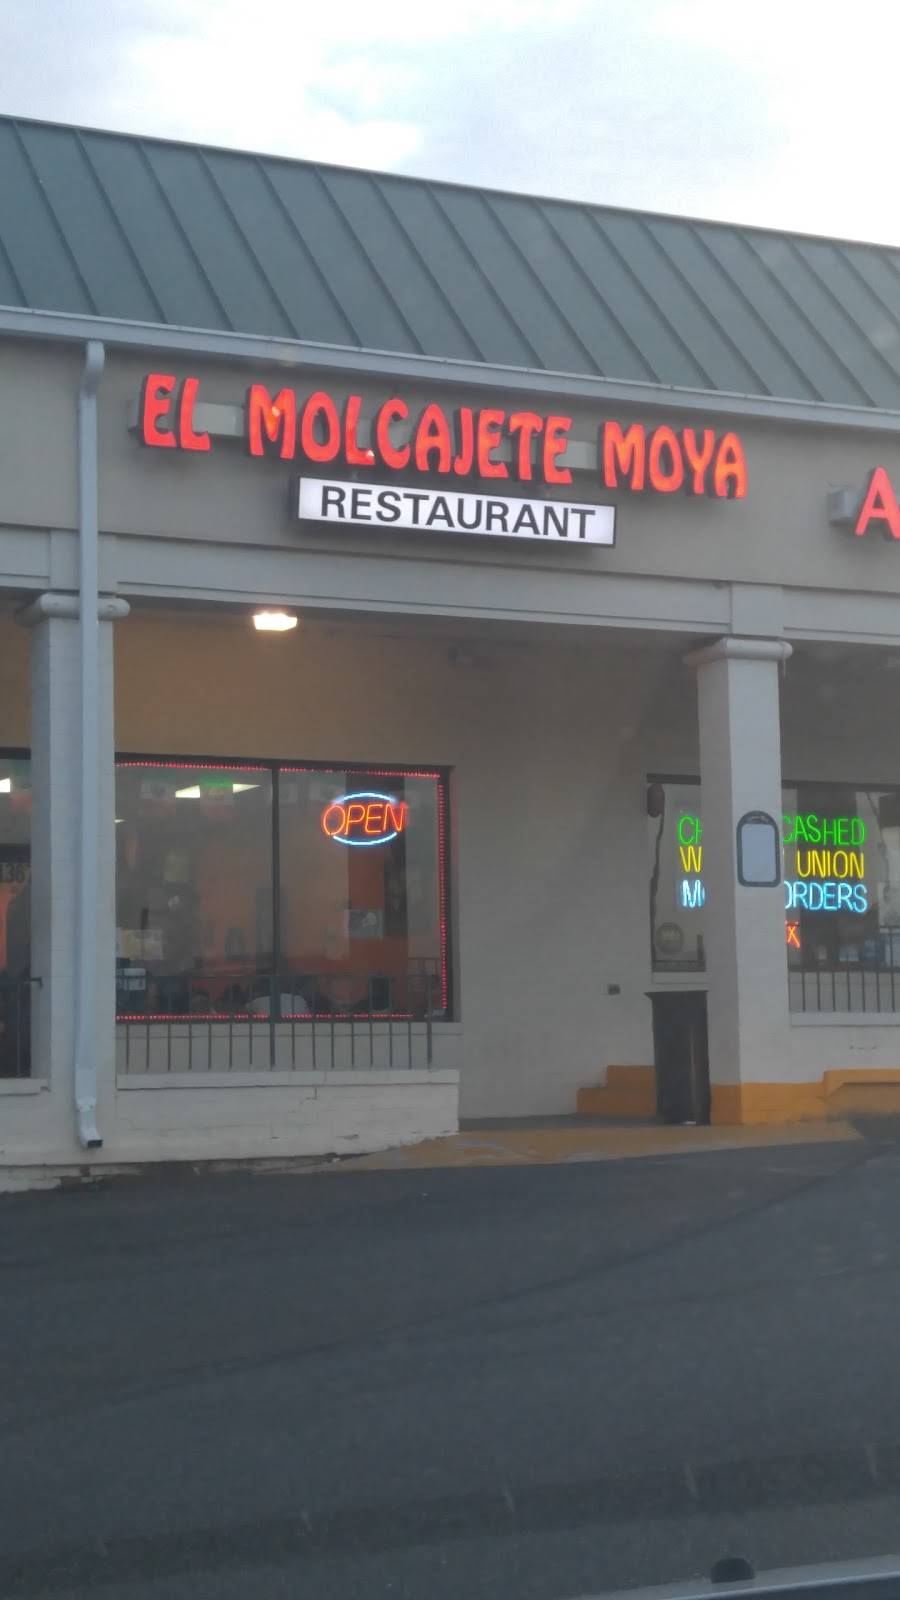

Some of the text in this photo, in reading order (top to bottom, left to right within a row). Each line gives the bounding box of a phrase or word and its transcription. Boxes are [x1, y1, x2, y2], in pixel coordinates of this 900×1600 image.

[143, 374, 748, 499] EL MOLCAJETE MOYA
[321, 485, 596, 539] RESTAURANT
[321, 803, 408, 836] OPEN
[797, 850, 864, 879] UNION
